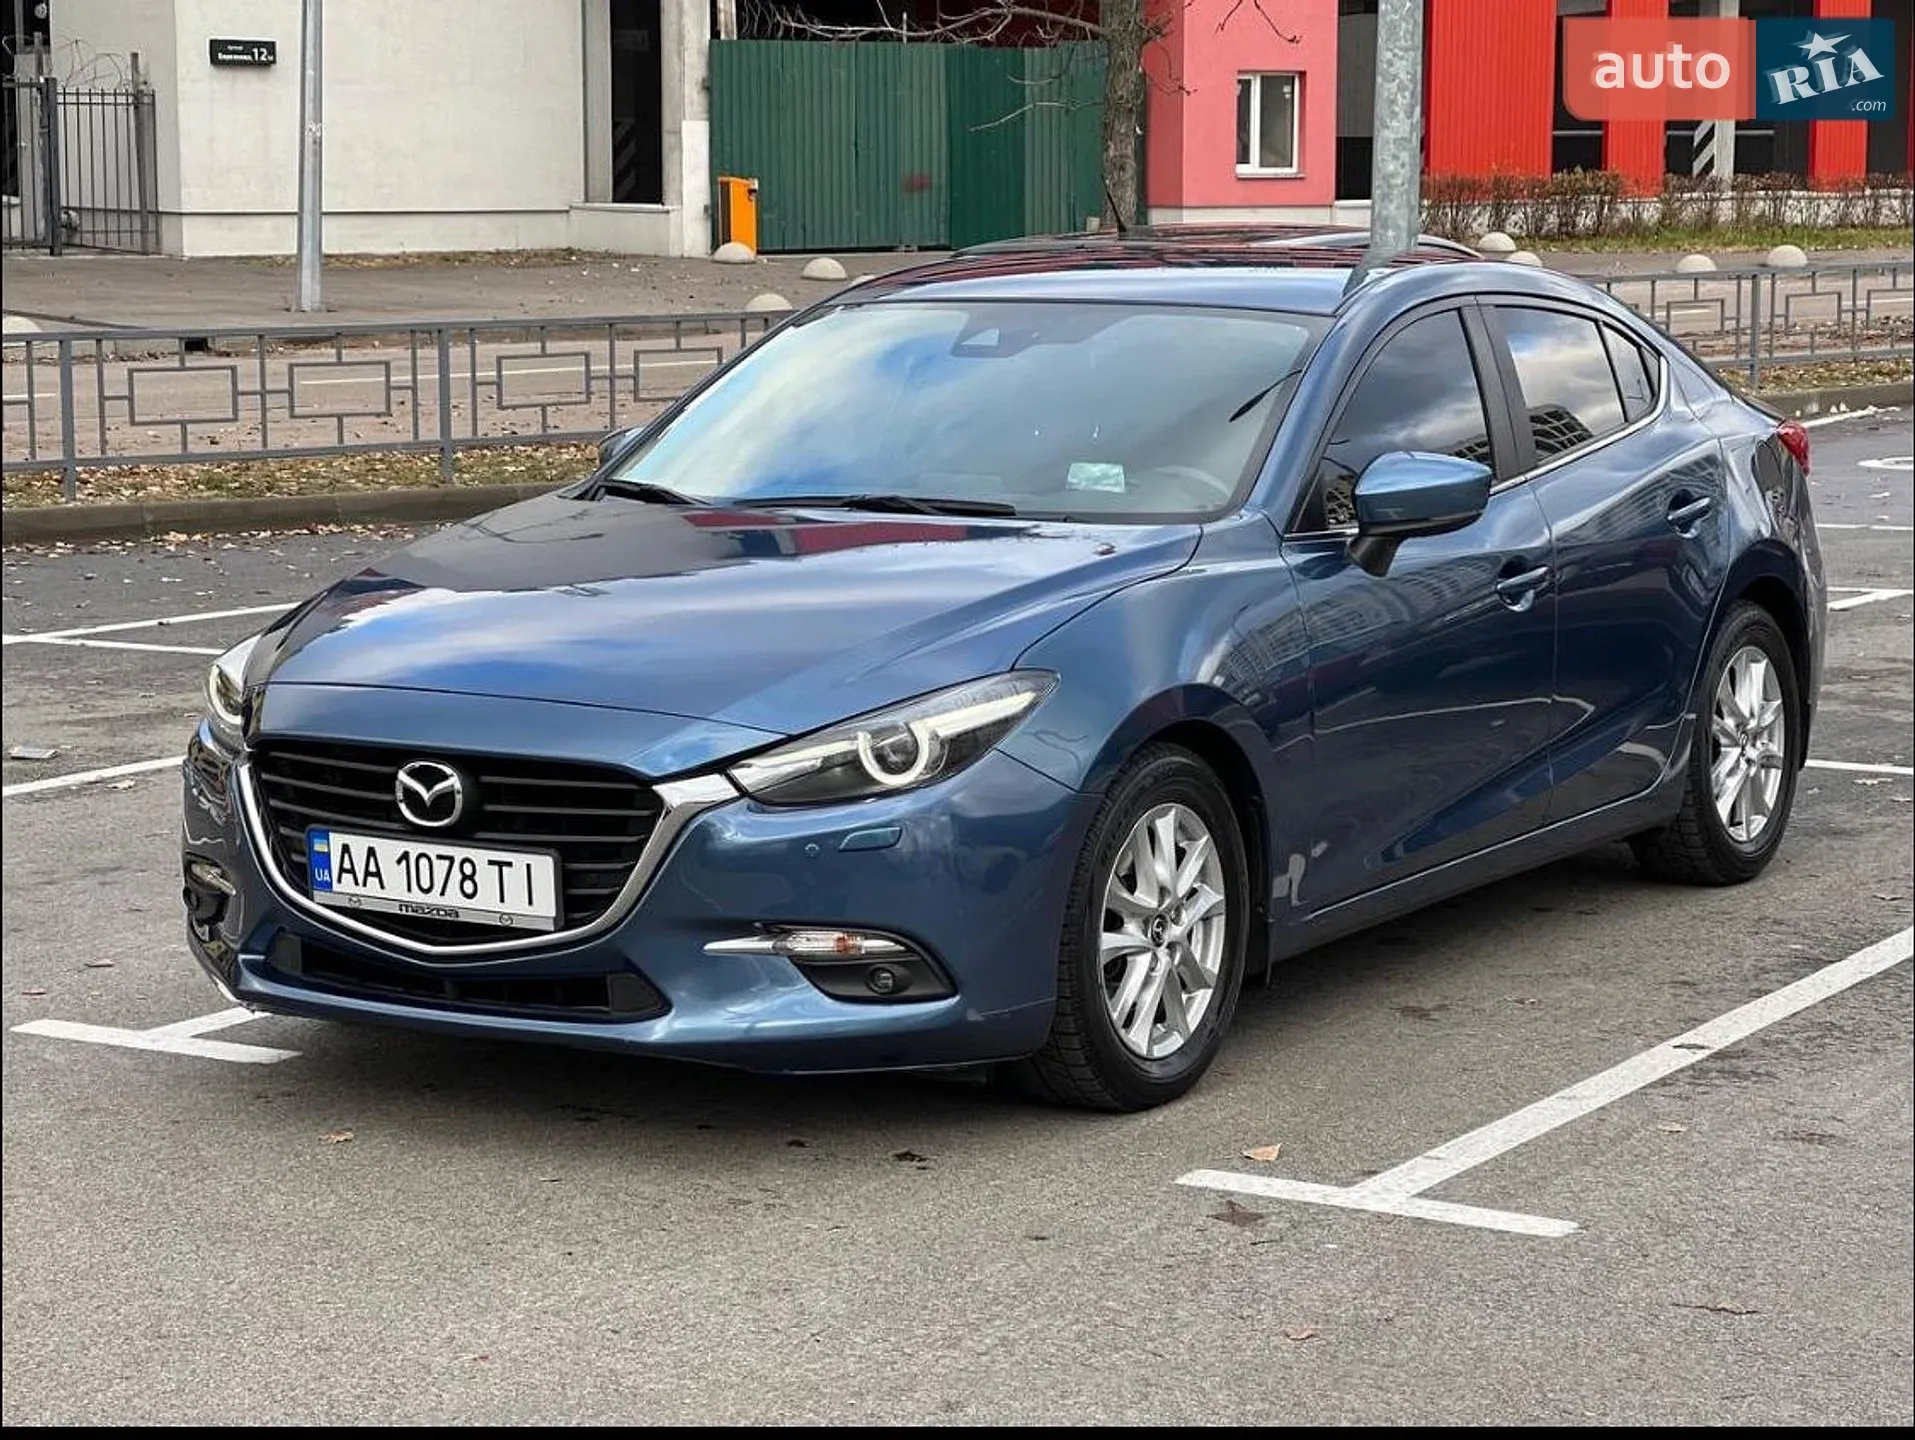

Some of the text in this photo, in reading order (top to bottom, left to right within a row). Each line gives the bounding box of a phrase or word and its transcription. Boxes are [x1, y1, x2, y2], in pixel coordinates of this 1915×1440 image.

[315, 868, 331, 882] UA
[337, 843, 385, 890] AA
[396, 850, 478, 900] 1078
[399, 903, 460, 919] mazda
